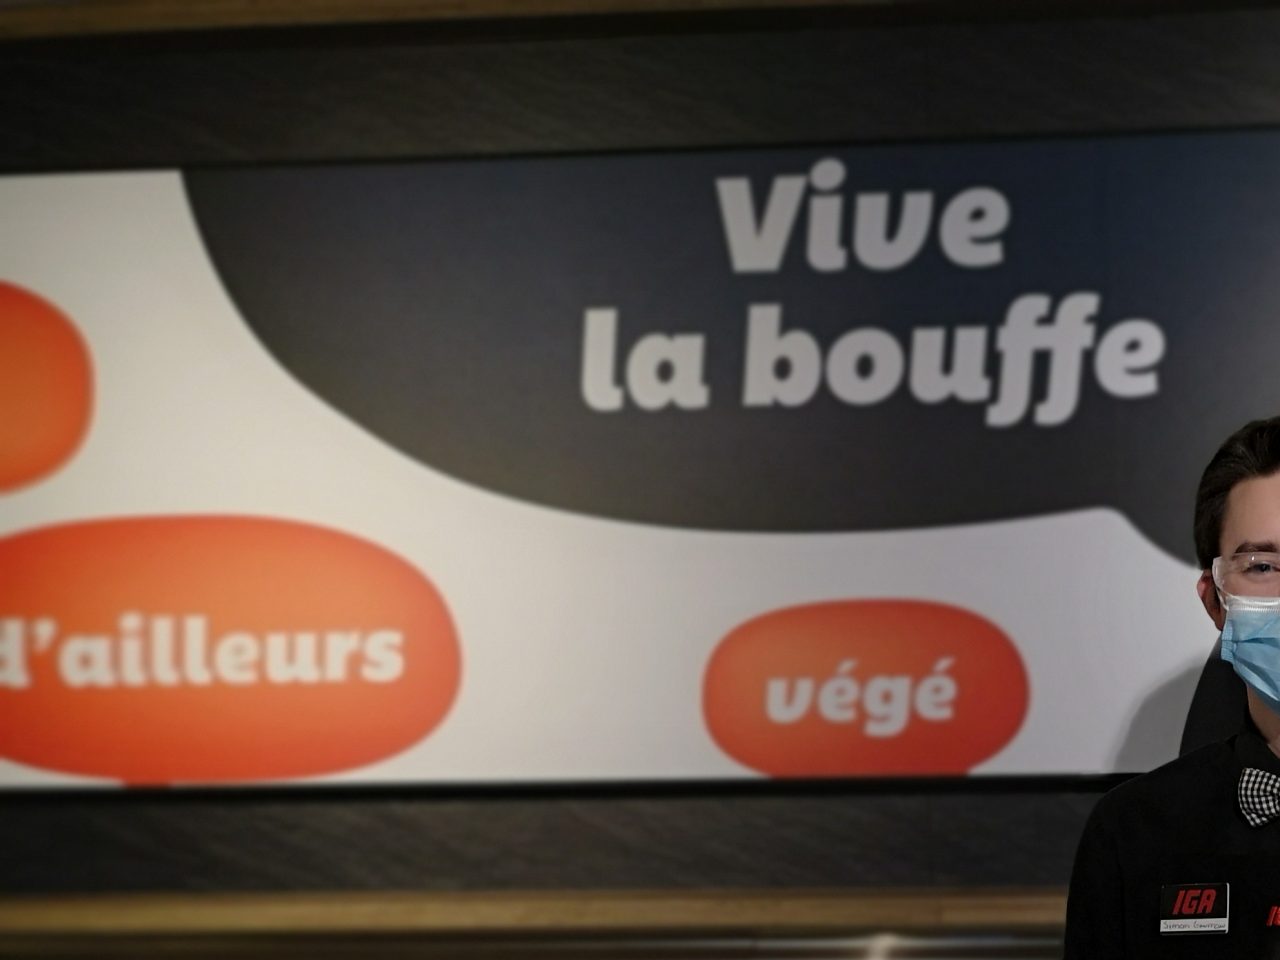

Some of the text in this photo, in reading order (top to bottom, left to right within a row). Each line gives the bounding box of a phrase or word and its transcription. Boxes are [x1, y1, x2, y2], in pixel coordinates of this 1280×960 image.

[715, 157, 1011, 273] Vive
[582, 292, 1166, 427] la bouffe
[765, 657, 958, 738] végé
[1172, 889, 1217, 915] IGA
